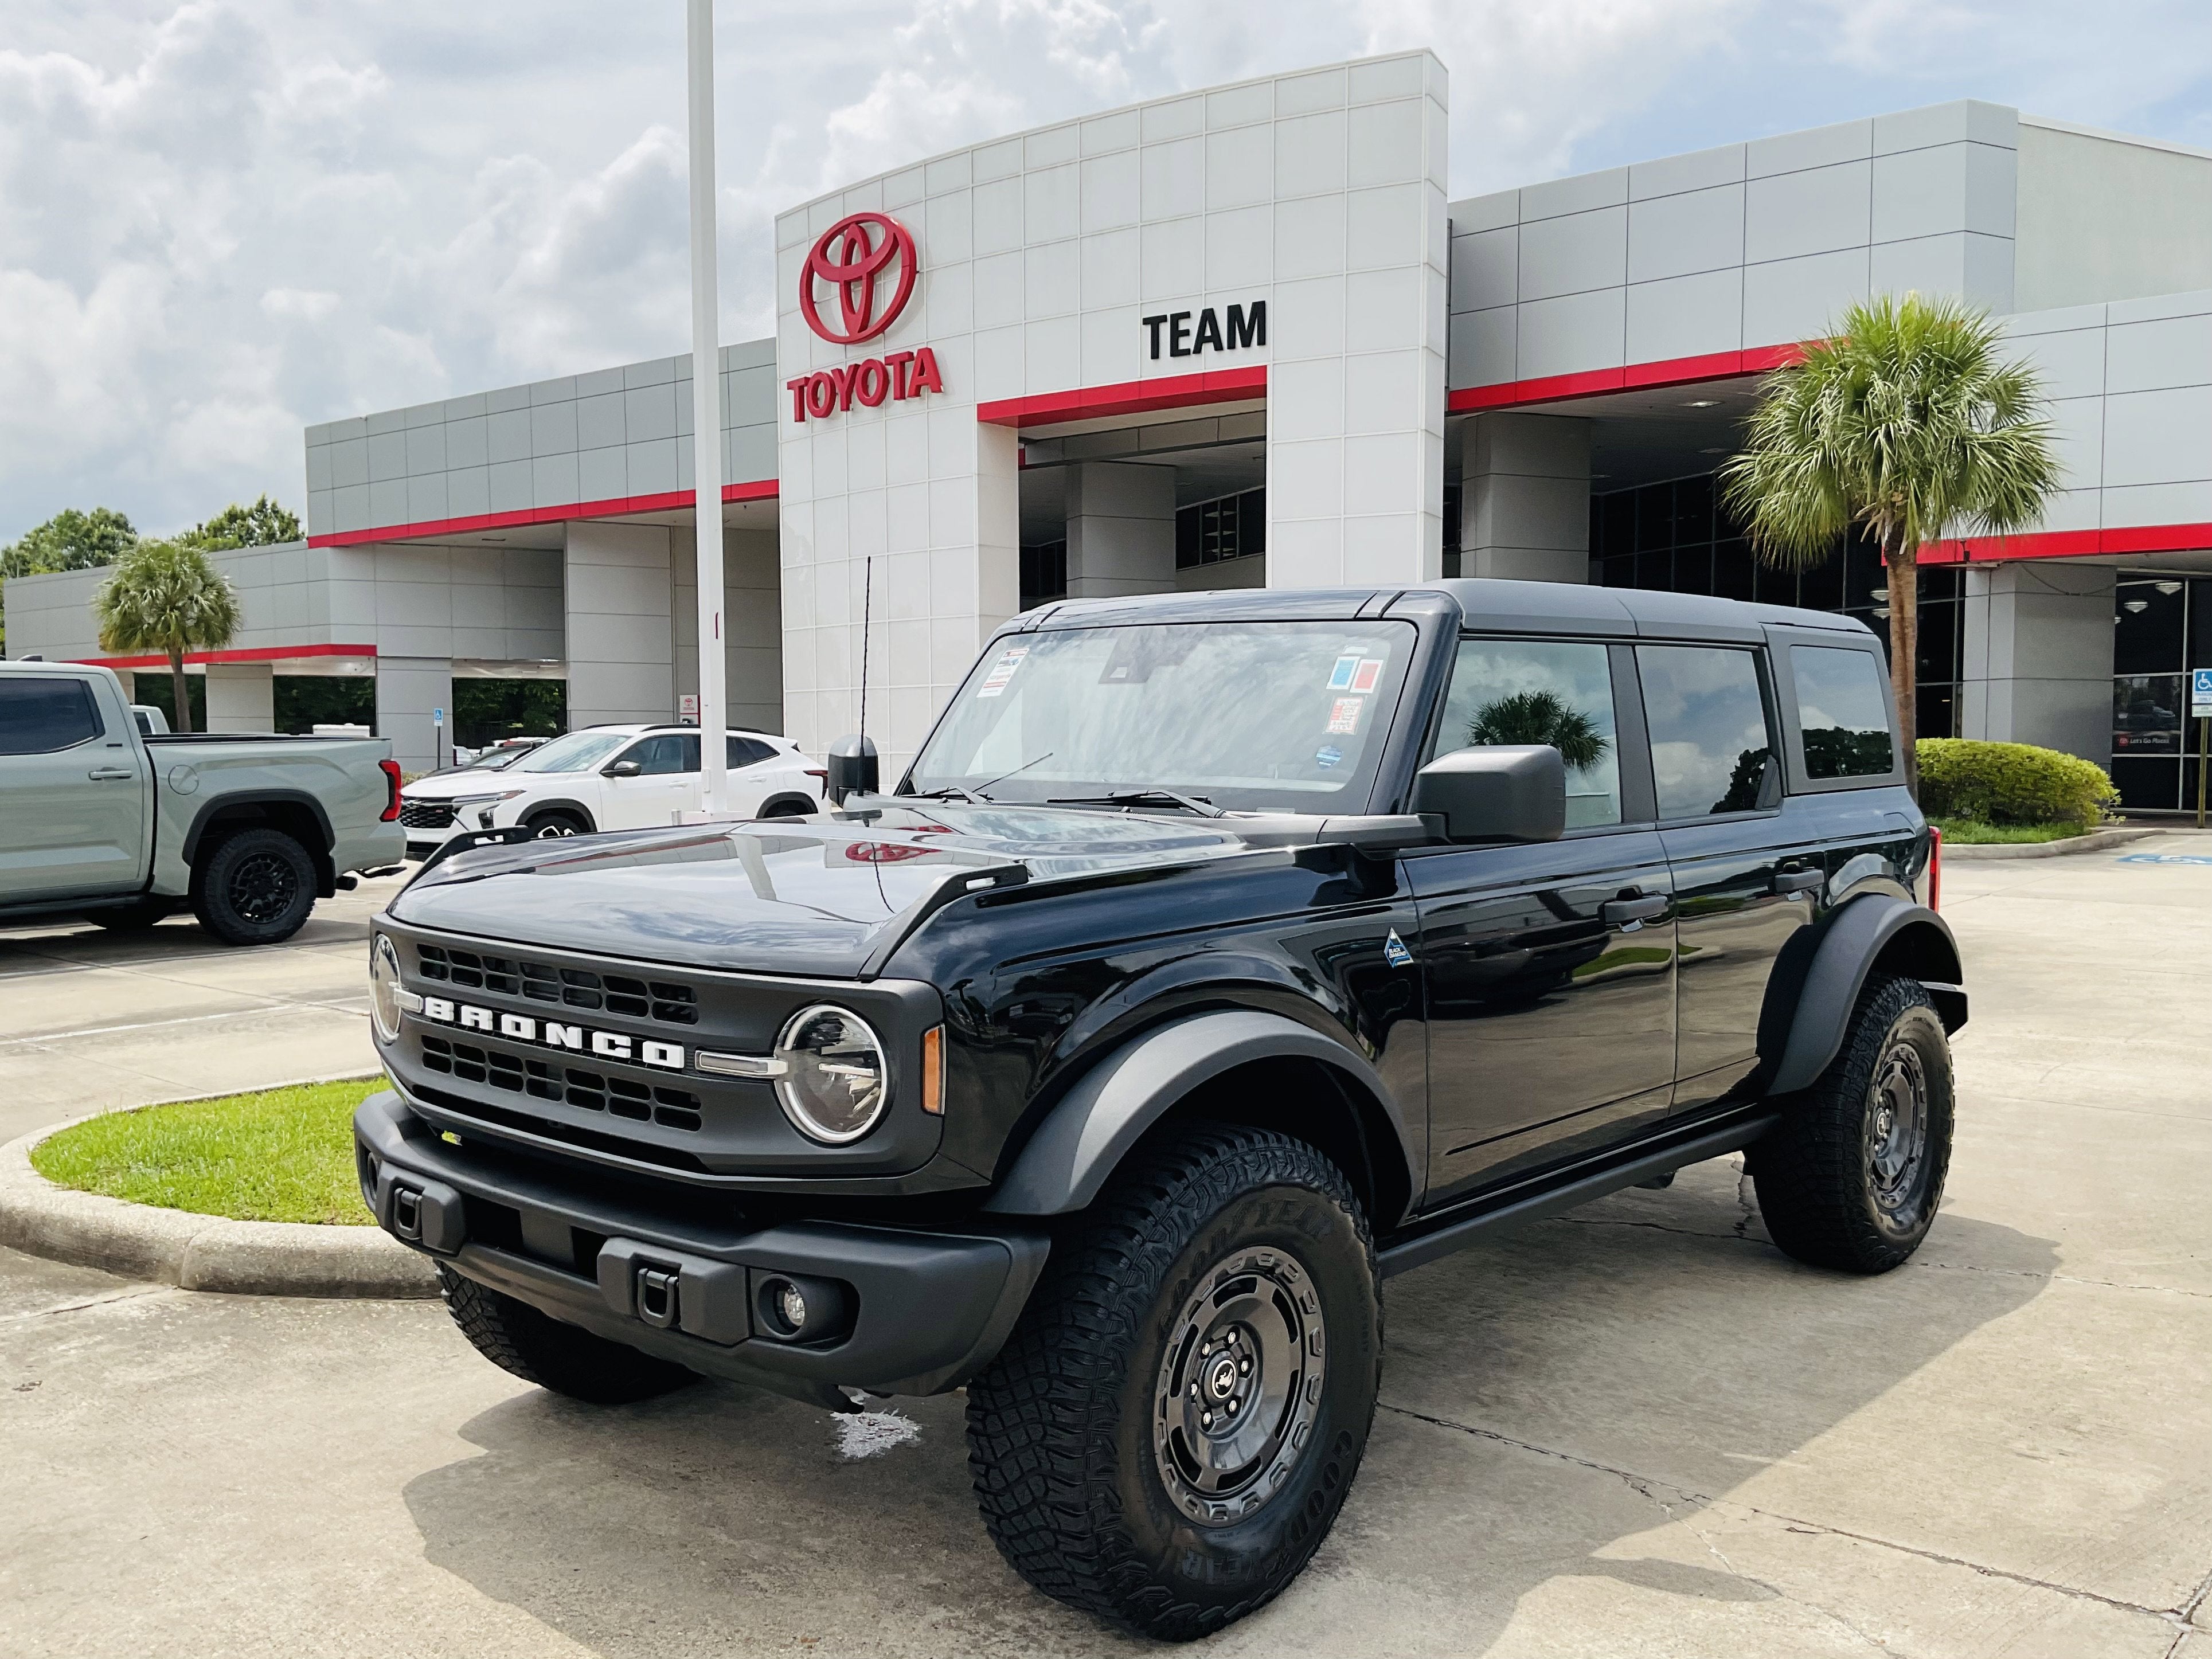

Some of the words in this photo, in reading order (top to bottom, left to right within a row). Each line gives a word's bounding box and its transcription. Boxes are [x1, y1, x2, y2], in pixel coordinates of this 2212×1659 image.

[1142, 300, 1266, 359] TEAM
[787, 347, 943, 422] TOYOTA
[425, 996, 685, 1069] BRONCO
